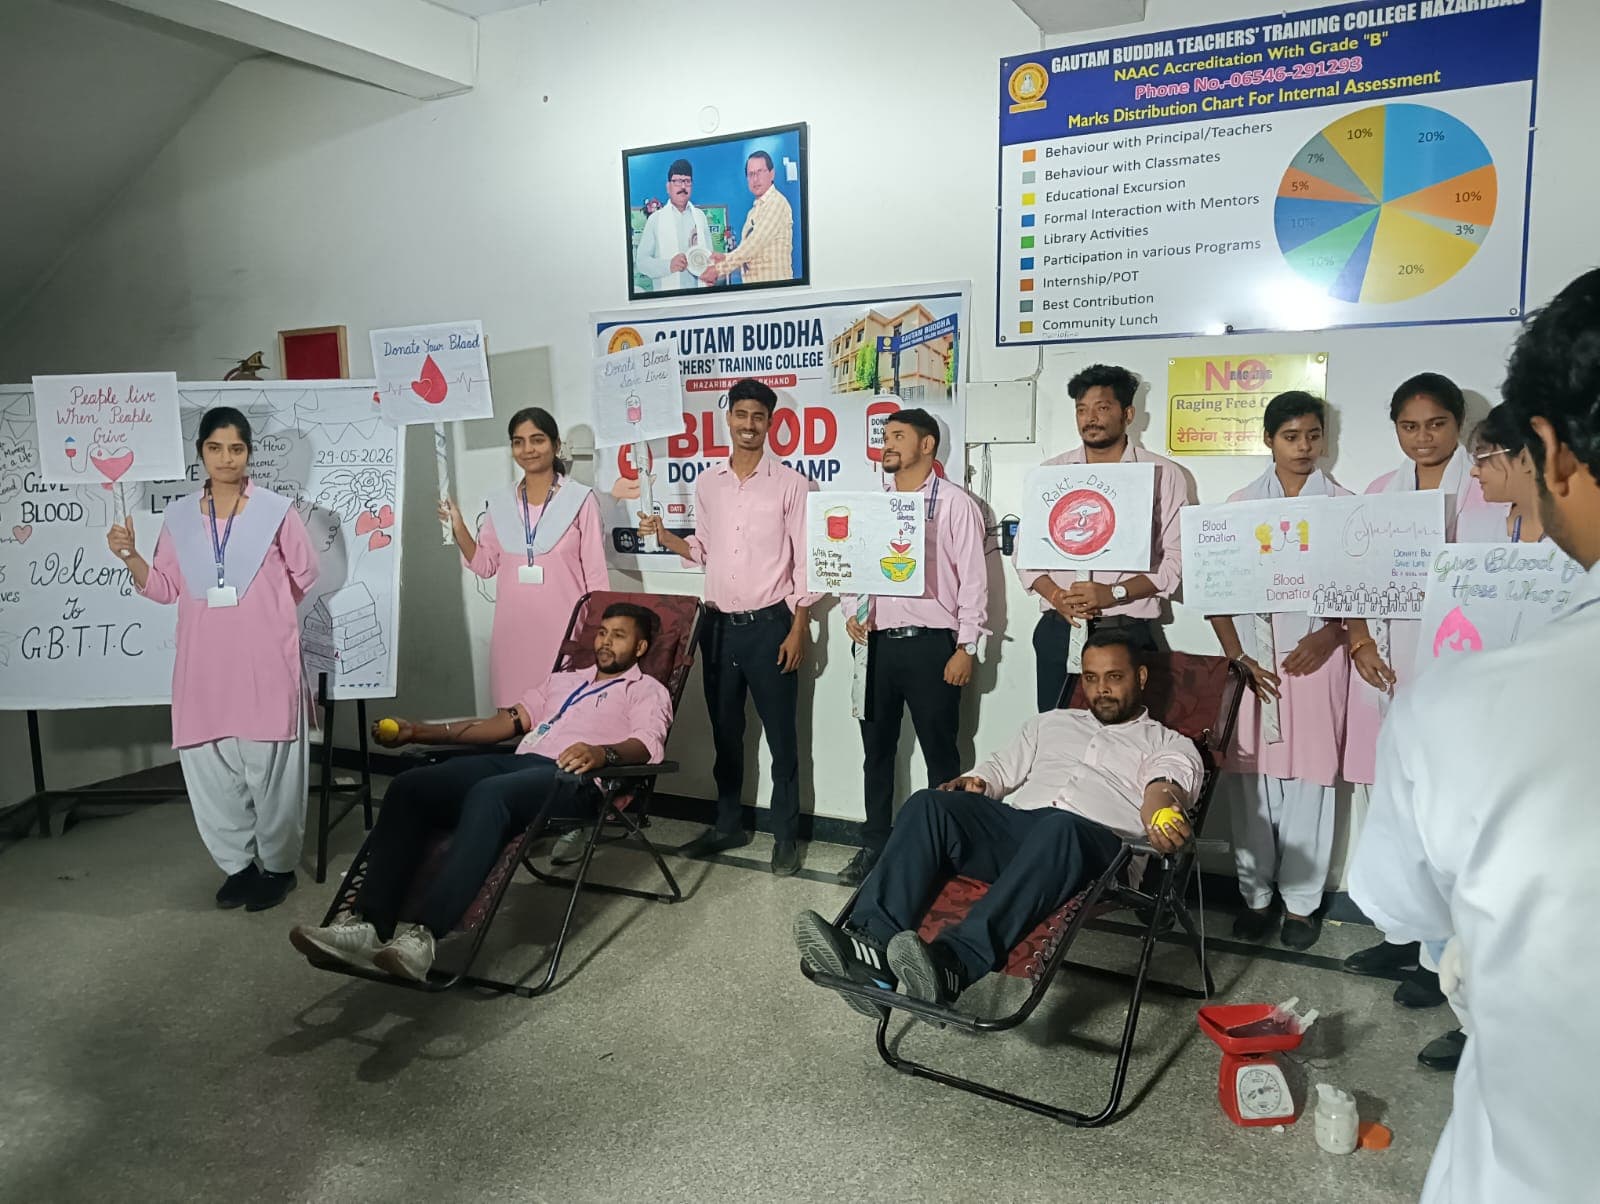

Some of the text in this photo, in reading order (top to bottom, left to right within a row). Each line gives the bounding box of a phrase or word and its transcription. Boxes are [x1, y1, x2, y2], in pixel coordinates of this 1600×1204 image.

[1051, 50, 1109, 73] GAUTAM
[1113, 40, 1174, 64] BUDDHA
[1177, 28, 1260, 53] TEACHERS'
[1263, 15, 1340, 42] TRAINING
[1343, 3, 1417, 31] COLLEGE
[1114, 31, 1389, 82] NAAC Accreditation With Grade "B"
[1068, 70, 1441, 128] Marks Distribution Chart For Internal Assessment
[1135, 82, 1190, 100] Phone
[1045, 121, 1273, 158] Behaviour with Principal/Teachers
[1347, 127, 1373, 140] 10%
[1418, 130, 1445, 143] 20%
[1045, 152, 1221, 181] Behaviour with Classmates
[1307, 153, 1325, 164] 7%
[1046, 178, 1186, 203] Educational Excursion
[1291, 180, 1309, 191] 5%
[1455, 191, 1482, 203] 10%
[1044, 194, 1260, 225] Formal Interaction with Mentors
[1043, 226, 1149, 248] Library Activities
[1455, 224, 1475, 236] 3%
[1043, 239, 1261, 267] Participation in various Programs
[1397, 263, 1424, 276] 20%
[1043, 270, 1139, 289] Internship/POT
[1043, 294, 1154, 311] Best Contribution
[1042, 313, 1158, 332] Community Lunch
[742, 318, 824, 351] BUDDHA
[384, 339, 420, 356] Donate
[720, 355, 772, 373] TRAINING
[776, 351, 824, 369] COLLEGE
[1176, 398, 1222, 412] Raging
[1226, 397, 1256, 409] Free
[21, 501, 83, 523] BLOOD
[1202, 520, 1227, 531] Blood
[1434, 551, 1478, 582] Give
[1273, 573, 1305, 585] Blood
[63, 597, 86, 620] To
